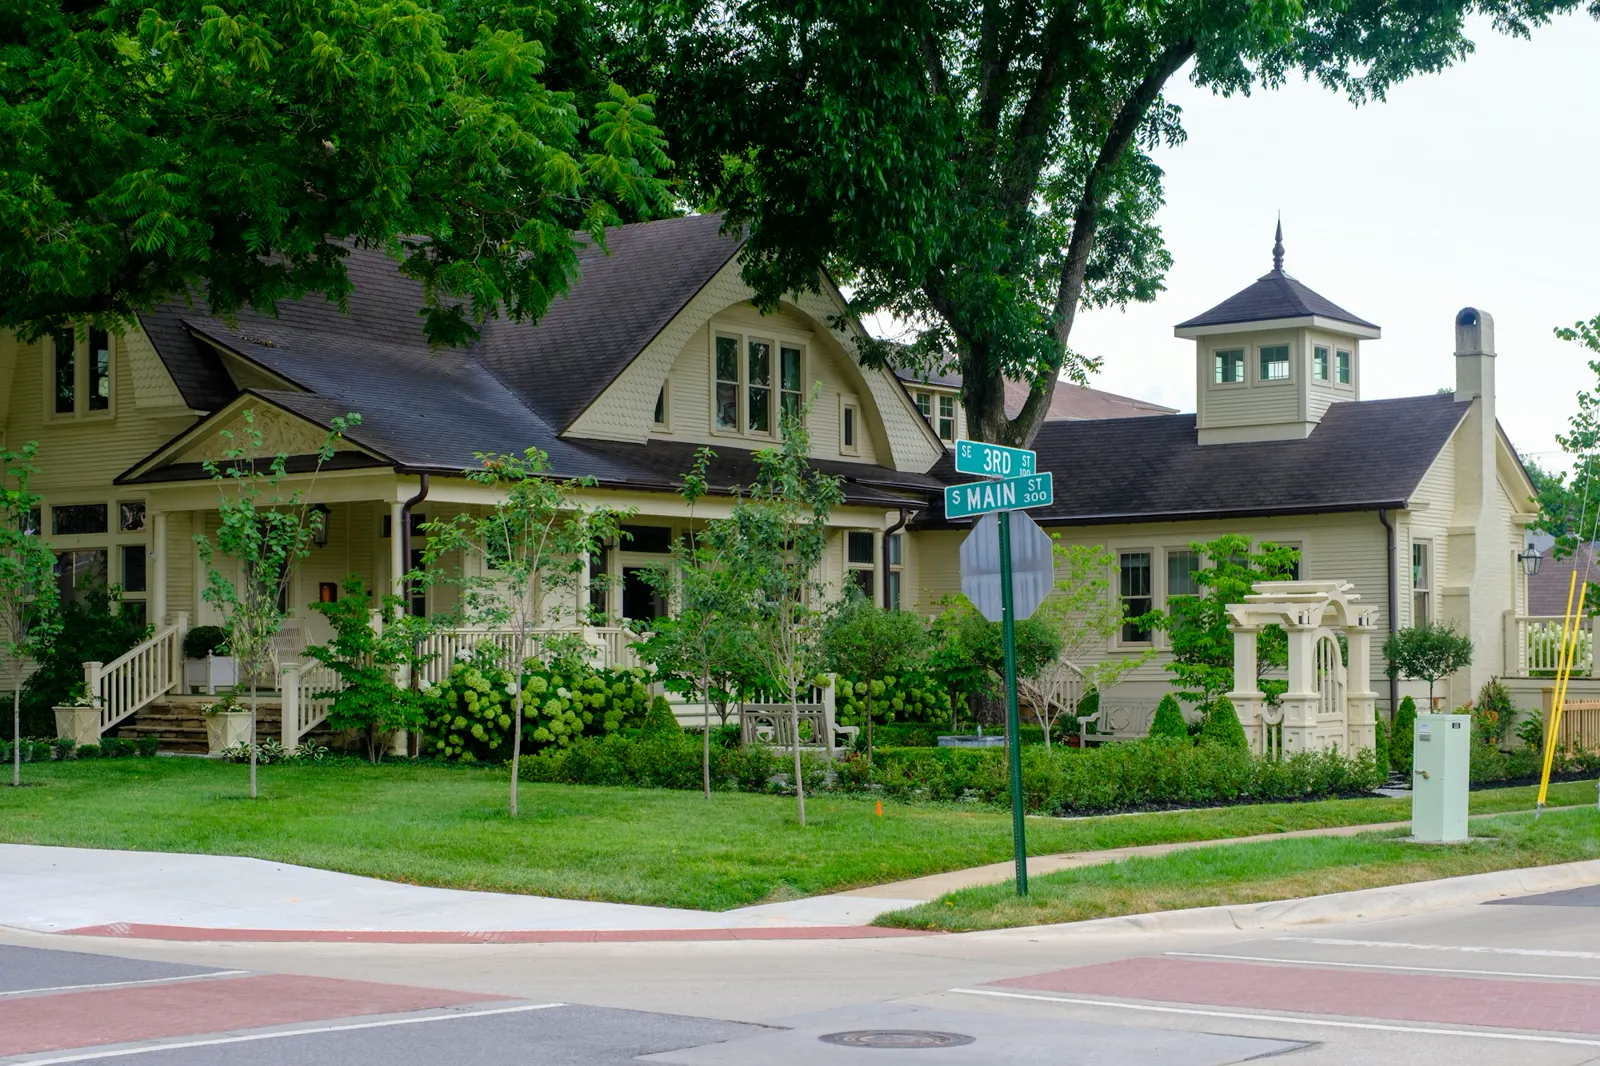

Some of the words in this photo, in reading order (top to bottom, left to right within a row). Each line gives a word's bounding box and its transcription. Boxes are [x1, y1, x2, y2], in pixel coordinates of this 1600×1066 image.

[961, 445, 972, 459] SE
[983, 448, 1011, 474] 3RD
[1022, 455, 1031, 468] ST
[952, 490, 961, 505] S
[967, 482, 1016, 512] MAIN
[1028, 478, 1043, 492] ST
[1023, 491, 1047, 503] 300
